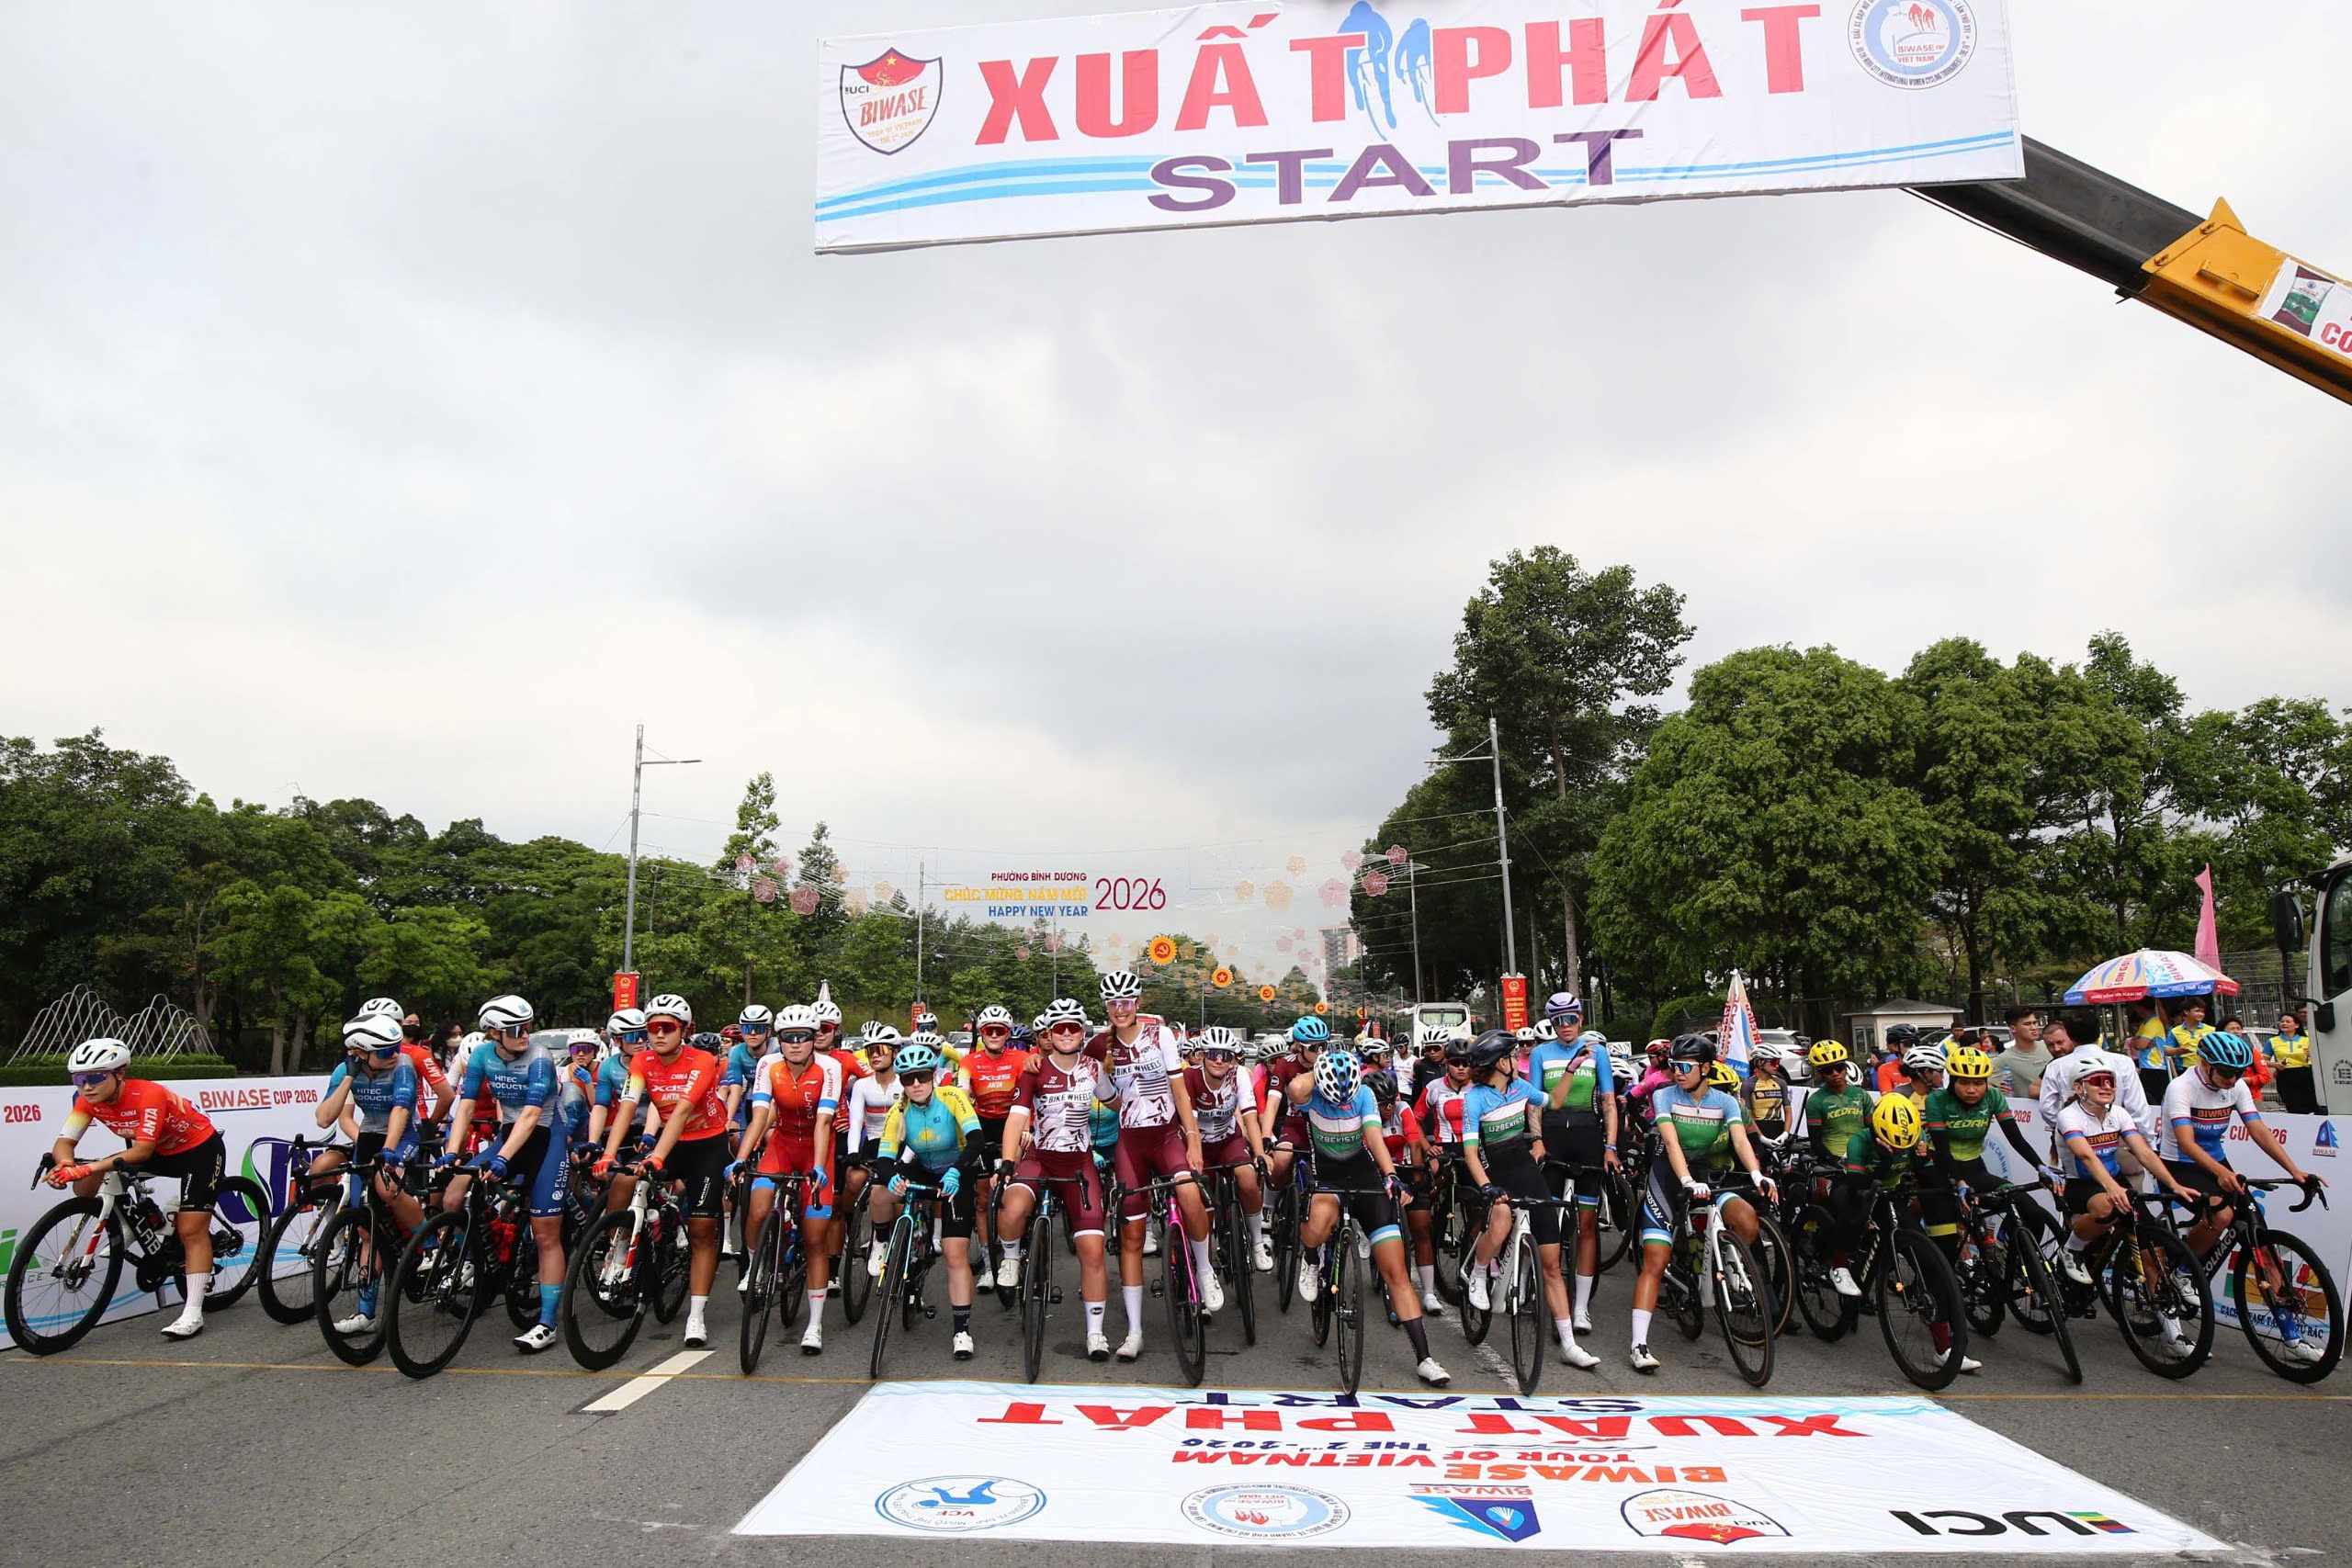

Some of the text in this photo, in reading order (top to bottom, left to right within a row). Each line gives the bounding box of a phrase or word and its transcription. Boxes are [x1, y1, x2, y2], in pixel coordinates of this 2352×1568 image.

[1897, 44, 1935, 53] BIWASE
[975, 0, 1821, 145] XUẤT PHÁT
[849, 85, 869, 95] UCI
[860, 86, 928, 127] BIWASE
[1147, 129, 1643, 211] START
[991, 870, 1087, 881] PHƯỜNG BÌNH DƯƠNG
[1095, 877, 1166, 910] 2026
[989, 906, 1089, 917] HAPPY NEW YEAR
[1116, 1059, 1162, 1076] BIKE WHEELS
[1544, 1068, 1593, 1079] UZBETAN
[487, 1080, 529, 1090] PRODUCTS
[199, 1089, 318, 1109] BIWASE CUP 2026
[1047, 1092, 1091, 1103] BIKE WHEELS
[4, 1104, 41, 1123] 2026
[1672, 1114, 1720, 1127] UZBEKISTAN
[1826, 1107, 1863, 1120] KEDAH
[2012, 1110, 2031, 1123] 2026
[2197, 1108, 2231, 1118] BIWASE
[141, 1108, 158, 1136] ANTA
[1896, 1106, 1909, 1142] KEDAH
[1946, 1117, 1990, 1130] KEDAH
[2087, 1134, 2119, 1145] BIWASE
[2312, 1147, 2336, 1156] BIWASE
[554, 1161, 565, 1188] FLUID
[1645, 1190, 1664, 1220] KISTAN
[123, 1198, 161, 1256] X-LAB
[1176, 1393, 1645, 1413] START
[977, 1402, 1873, 1444] XUẤT PHÁT
[1363, 1440, 1431, 1451] THE
[1171, 1450, 1634, 1467] TOUR OF VIETNAM
[1444, 1463, 1727, 1483] BIWASE
[1413, 1485, 1533, 1495] BIWASE
[1638, 1503, 1736, 1523] BIWASE
[1889, 1510, 2098, 1536] UCI
